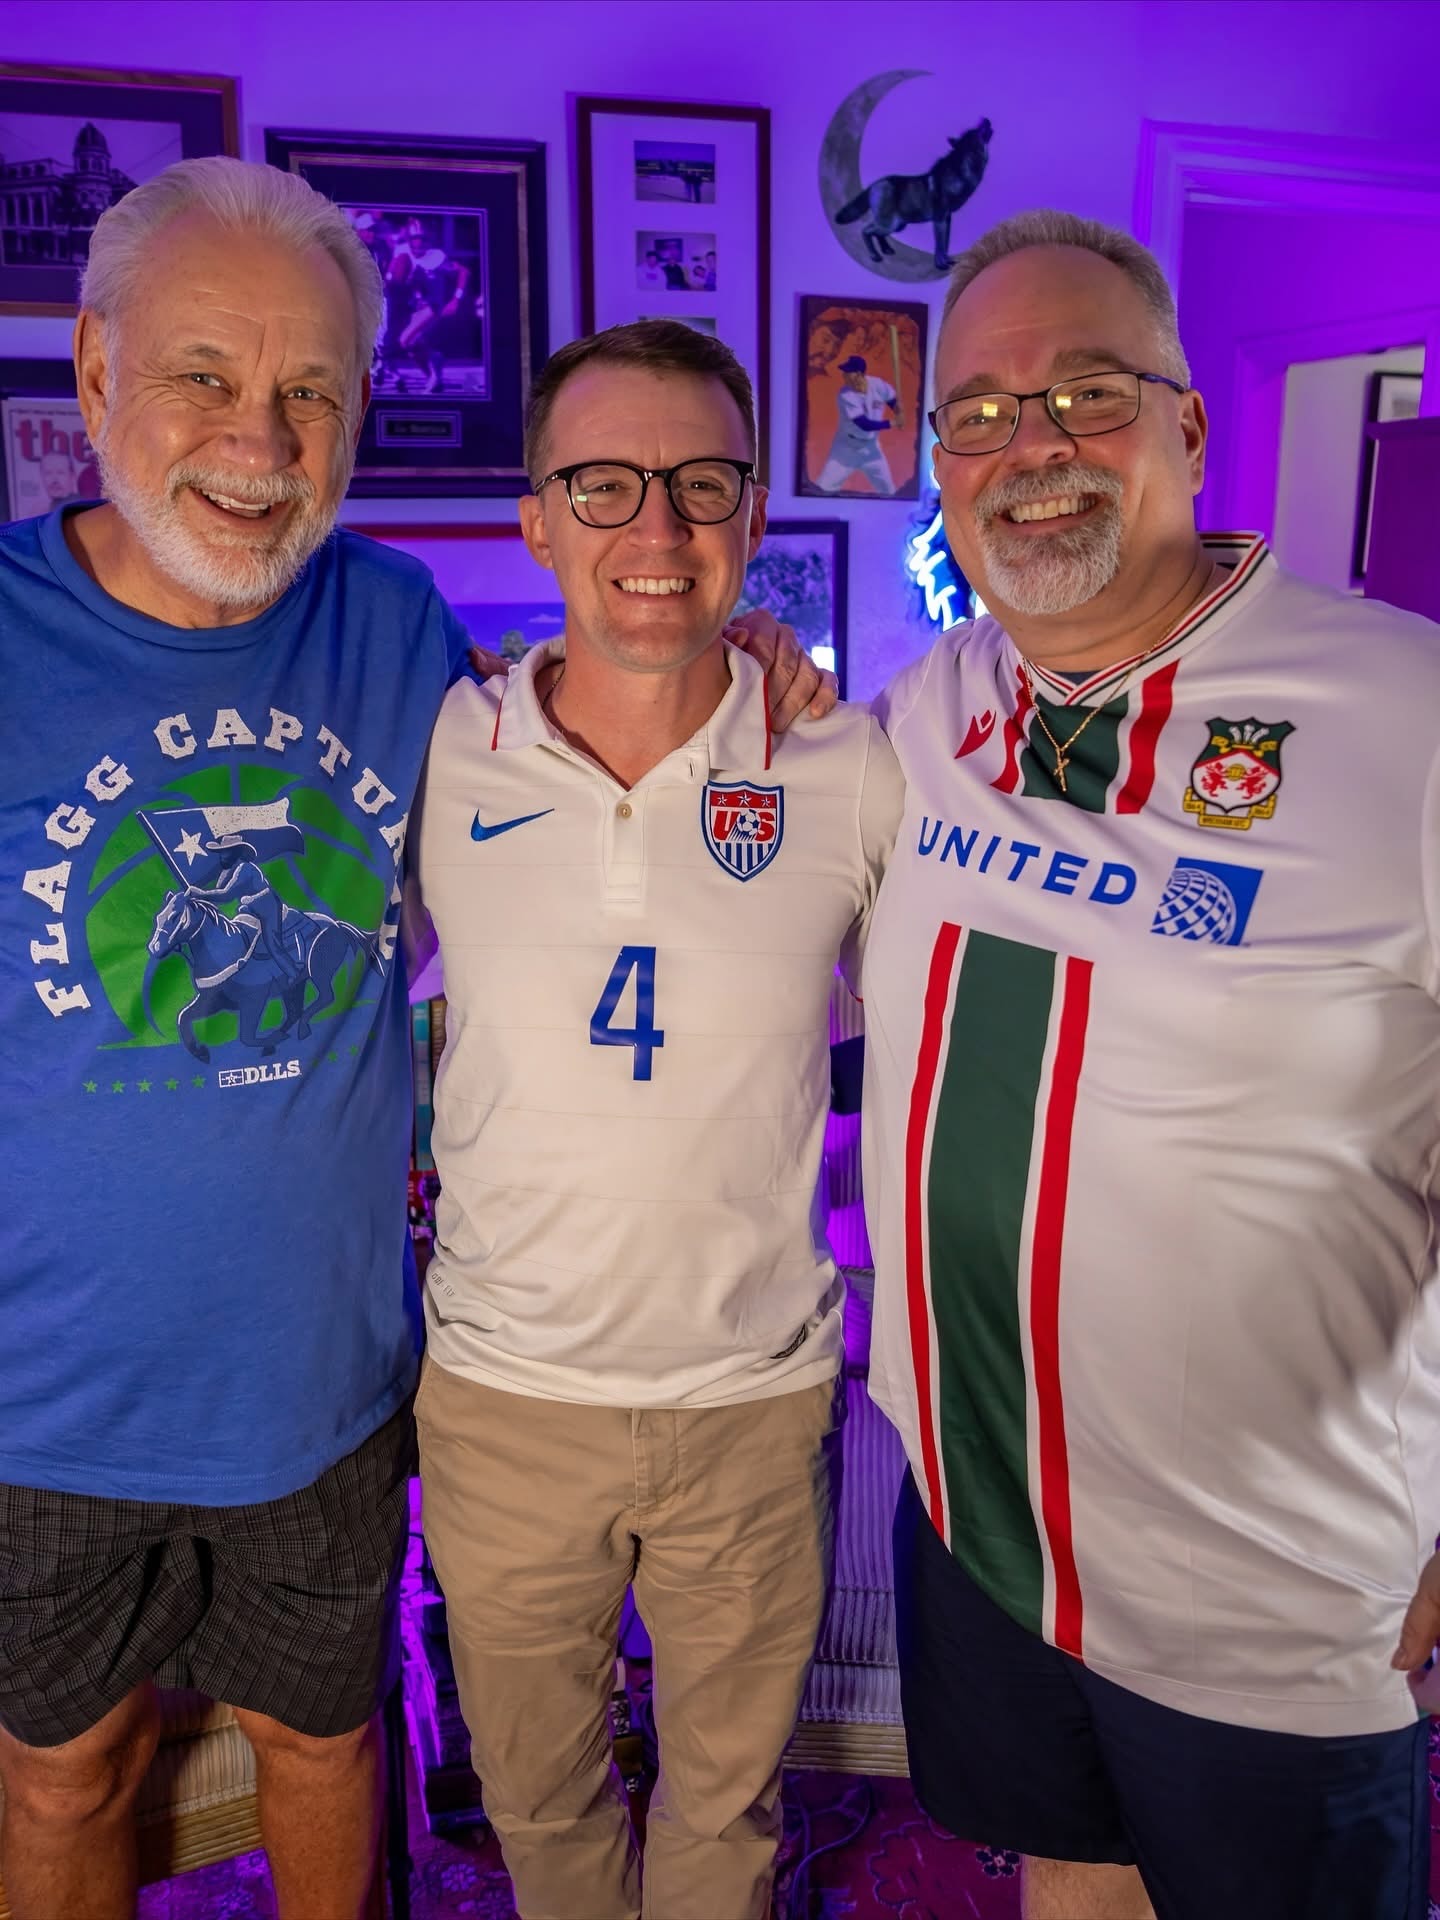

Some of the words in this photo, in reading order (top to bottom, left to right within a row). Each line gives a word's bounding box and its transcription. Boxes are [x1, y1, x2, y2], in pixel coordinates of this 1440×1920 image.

[22, 755, 134, 1018] FLAGG
[153, 707, 409, 960] CAPTUR
[713, 810, 776, 842] US
[918, 816, 1138, 905] UNITED
[590, 946, 665, 1081] 4
[244, 1060, 301, 1085] DLLS
